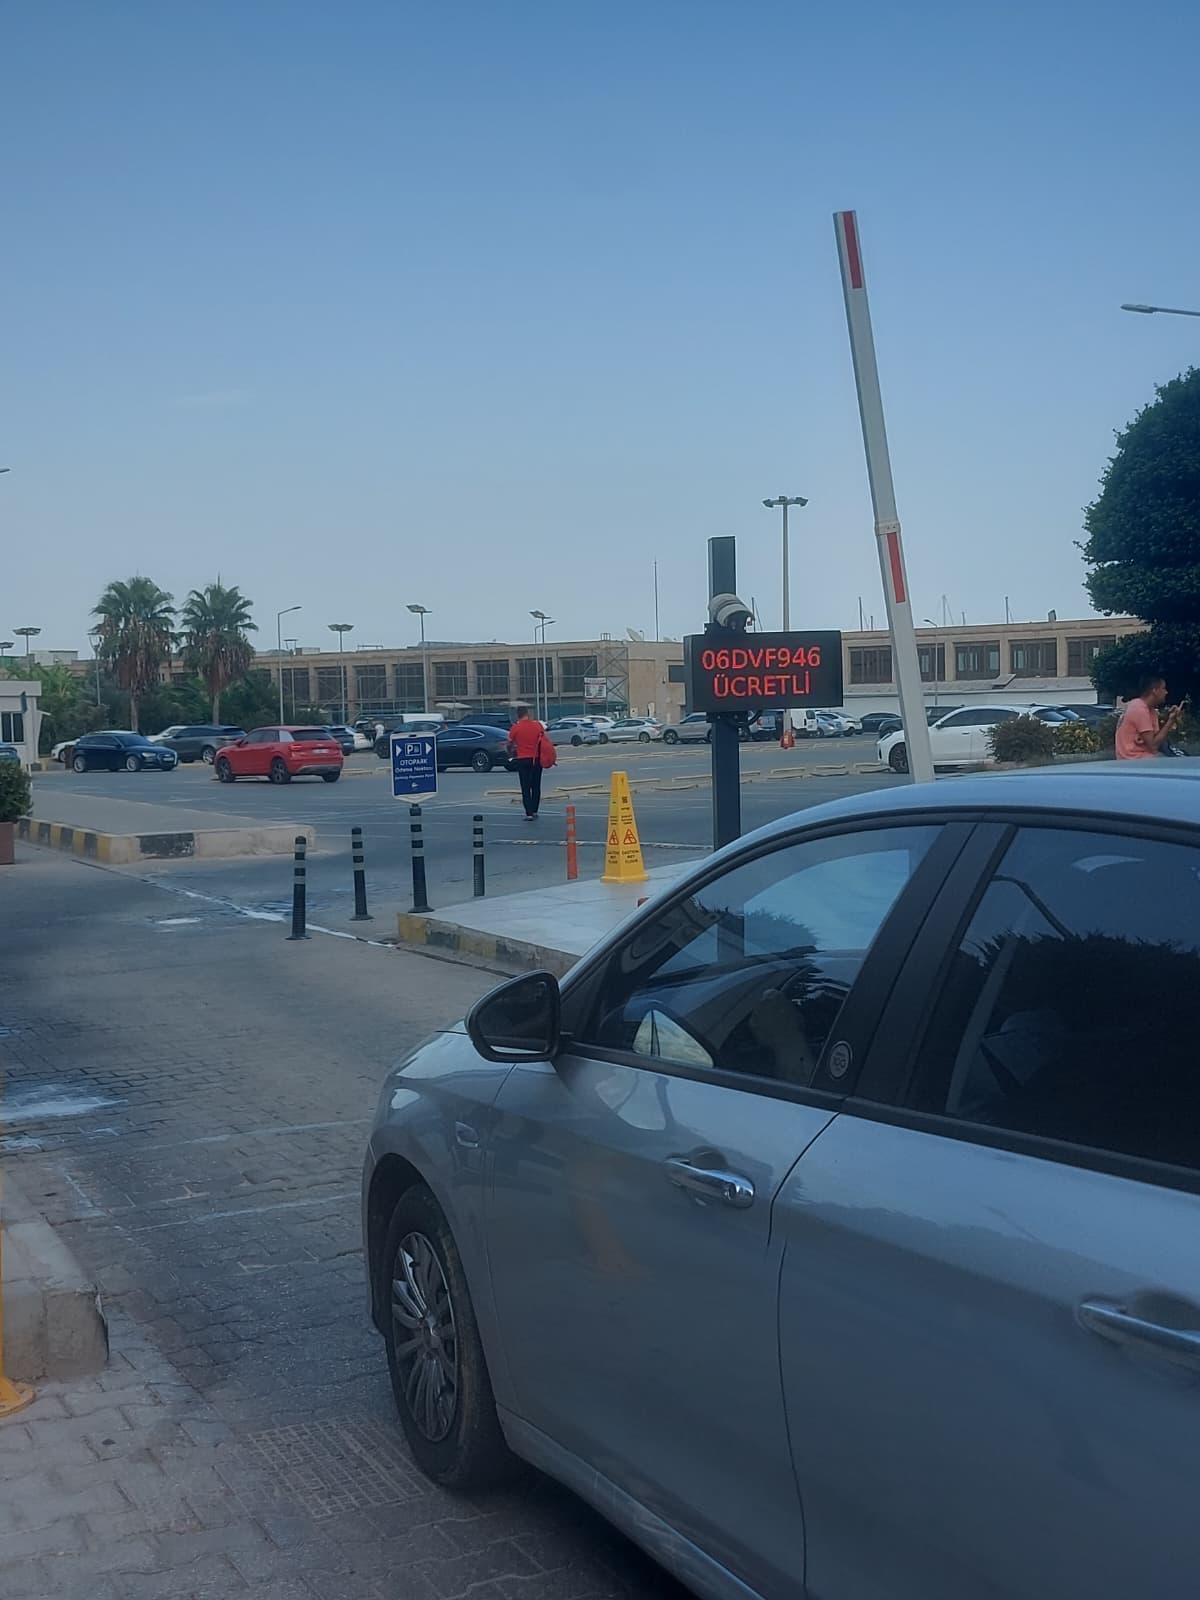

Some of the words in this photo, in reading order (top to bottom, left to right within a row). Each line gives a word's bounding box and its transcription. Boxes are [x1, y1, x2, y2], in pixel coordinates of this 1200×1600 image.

[702, 646, 821, 670] 06DVF946
[713, 670, 810, 697] ÜCRETLİ
[399, 758, 429, 766] OTOPARK
